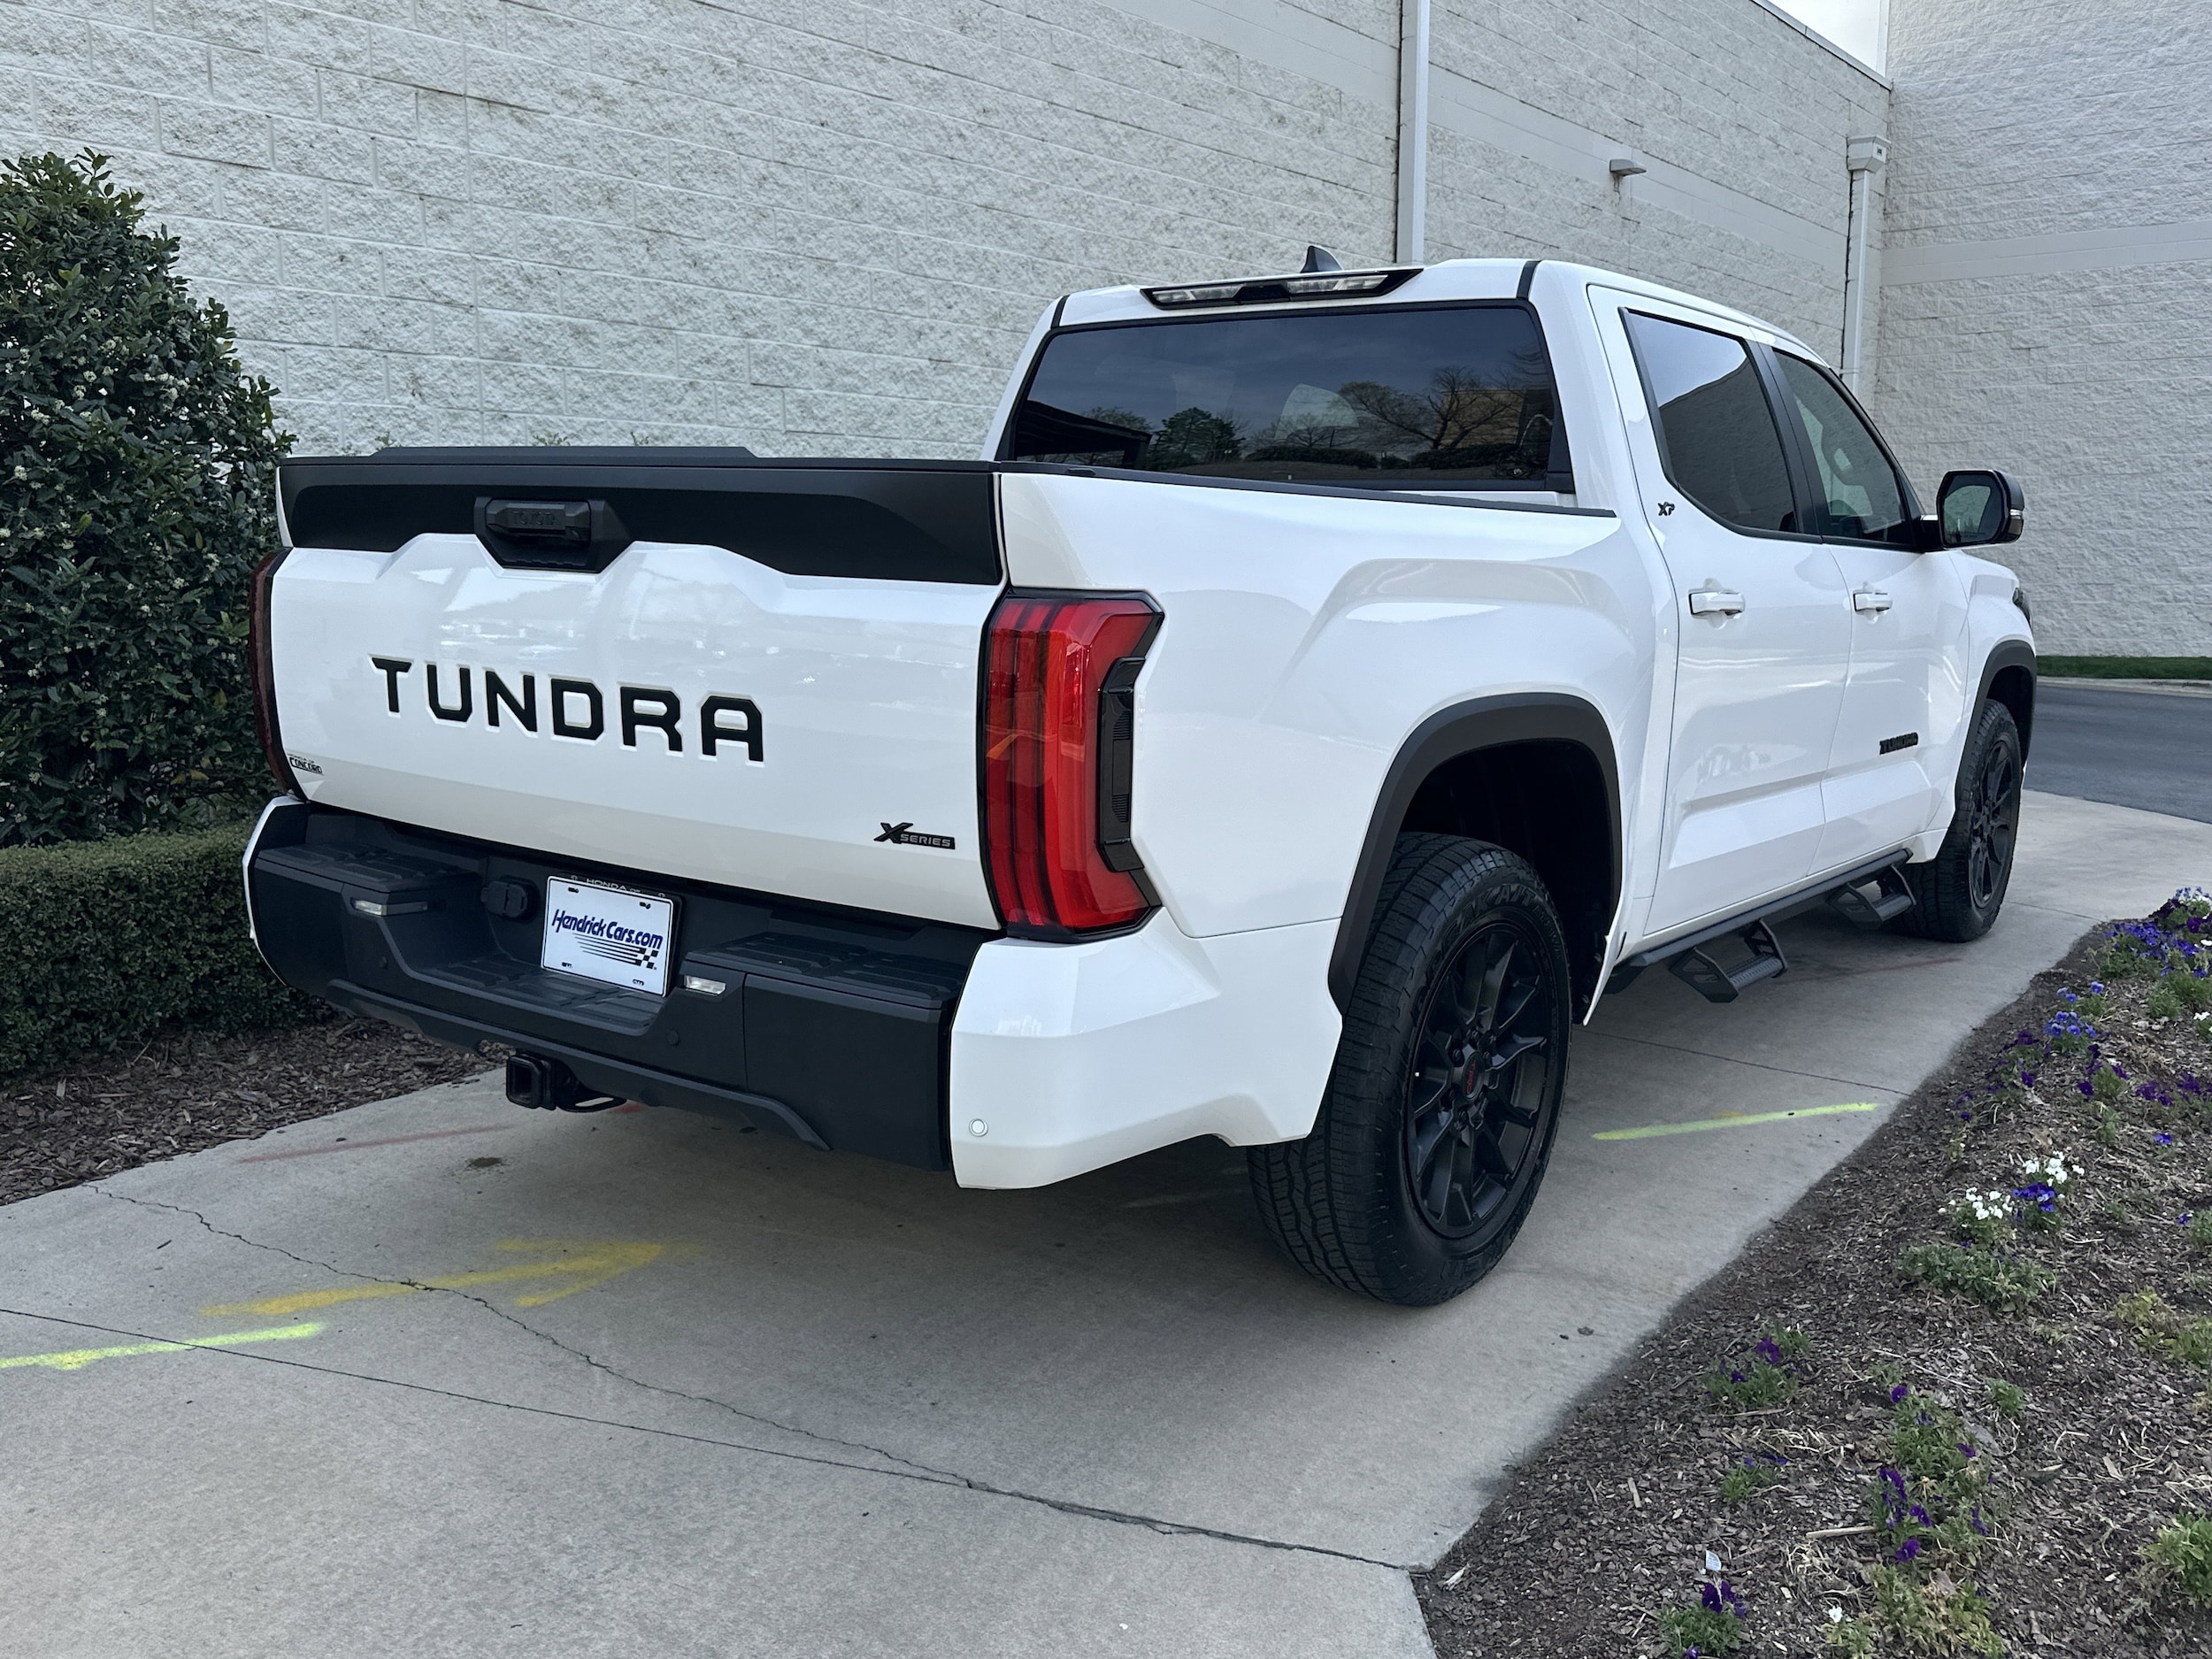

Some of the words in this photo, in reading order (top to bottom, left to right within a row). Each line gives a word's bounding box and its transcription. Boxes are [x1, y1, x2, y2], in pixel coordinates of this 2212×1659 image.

[1657, 501, 1675, 516] XP
[371, 657, 764, 762] TUNDRA
[900, 833, 951, 847] SERIES
[586, 878, 627, 892] HONDA
